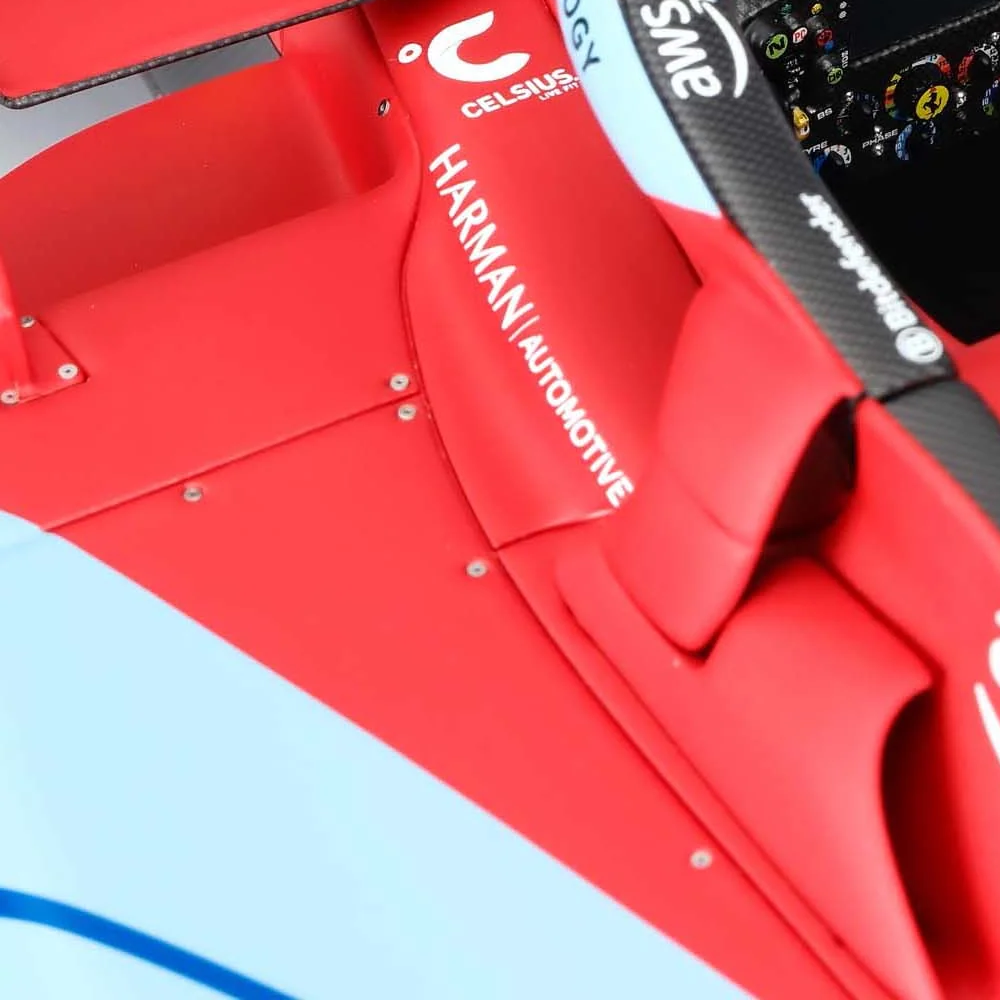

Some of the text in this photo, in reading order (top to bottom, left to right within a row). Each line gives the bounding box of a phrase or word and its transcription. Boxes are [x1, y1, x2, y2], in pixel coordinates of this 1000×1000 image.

[816, 107, 833, 121] BS
[861, 128, 899, 150] PHASE
[428, 142, 636, 509] HARMAN AUTOMOTIVE
